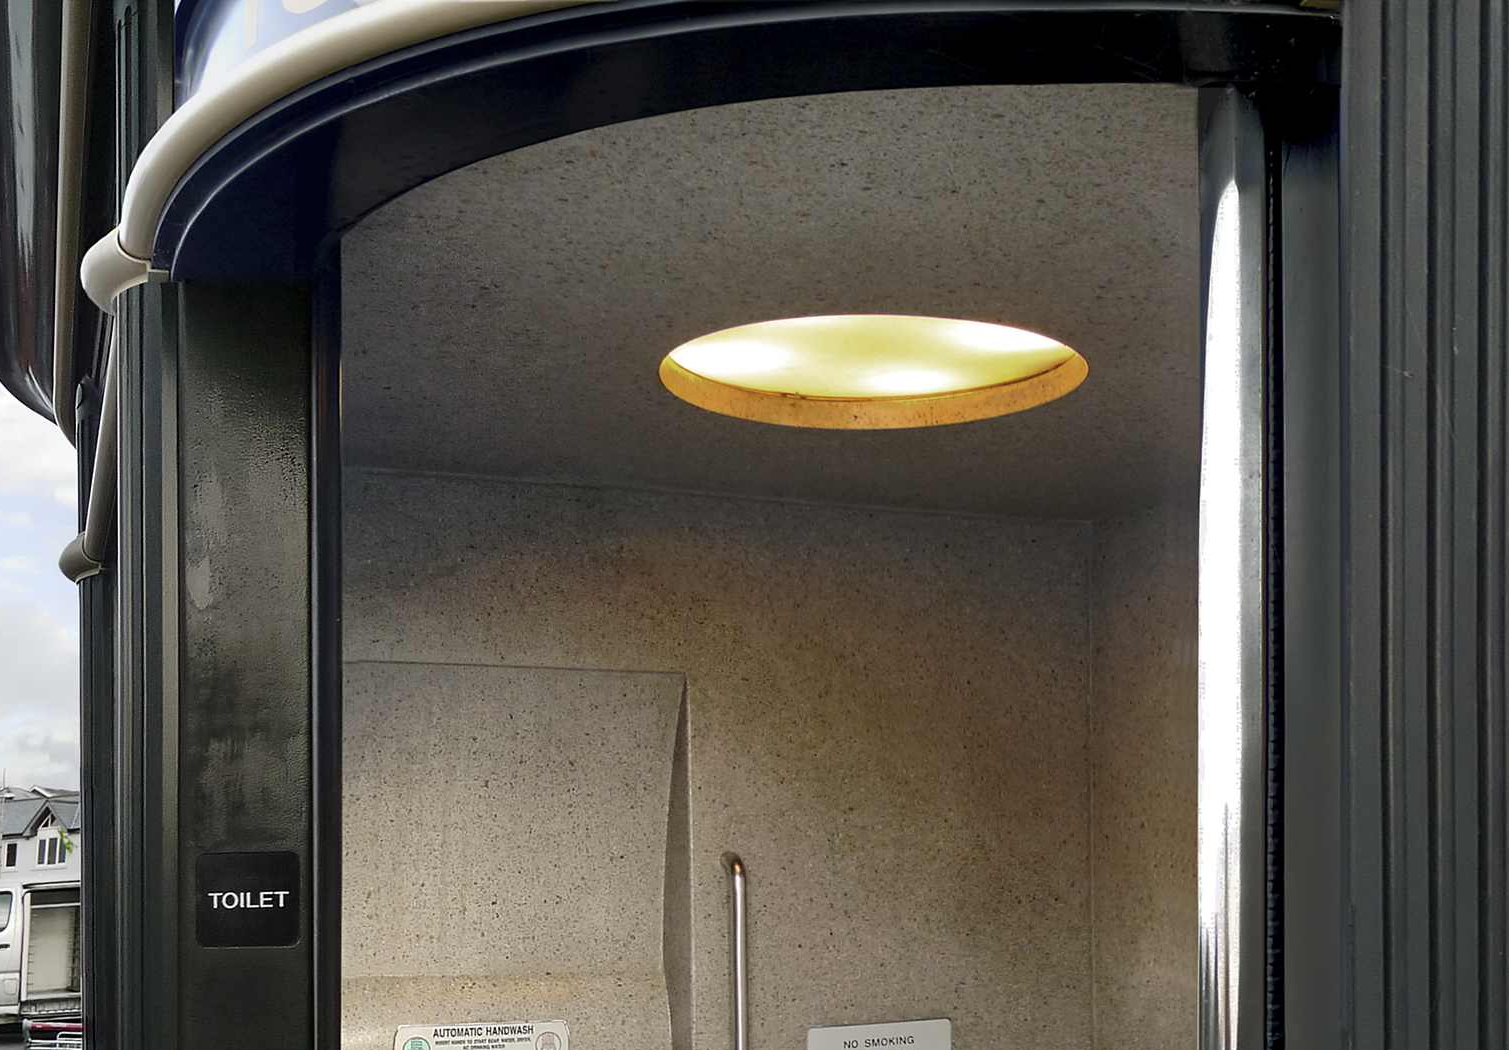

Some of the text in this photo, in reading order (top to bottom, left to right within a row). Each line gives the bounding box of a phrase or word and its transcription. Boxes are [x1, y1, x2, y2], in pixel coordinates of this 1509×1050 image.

[208, 891, 289, 909] TOILET
[433, 1025, 533, 1038] AUTOMATIC HANDWASH
[844, 1036, 914, 1049] NO SMOKING
